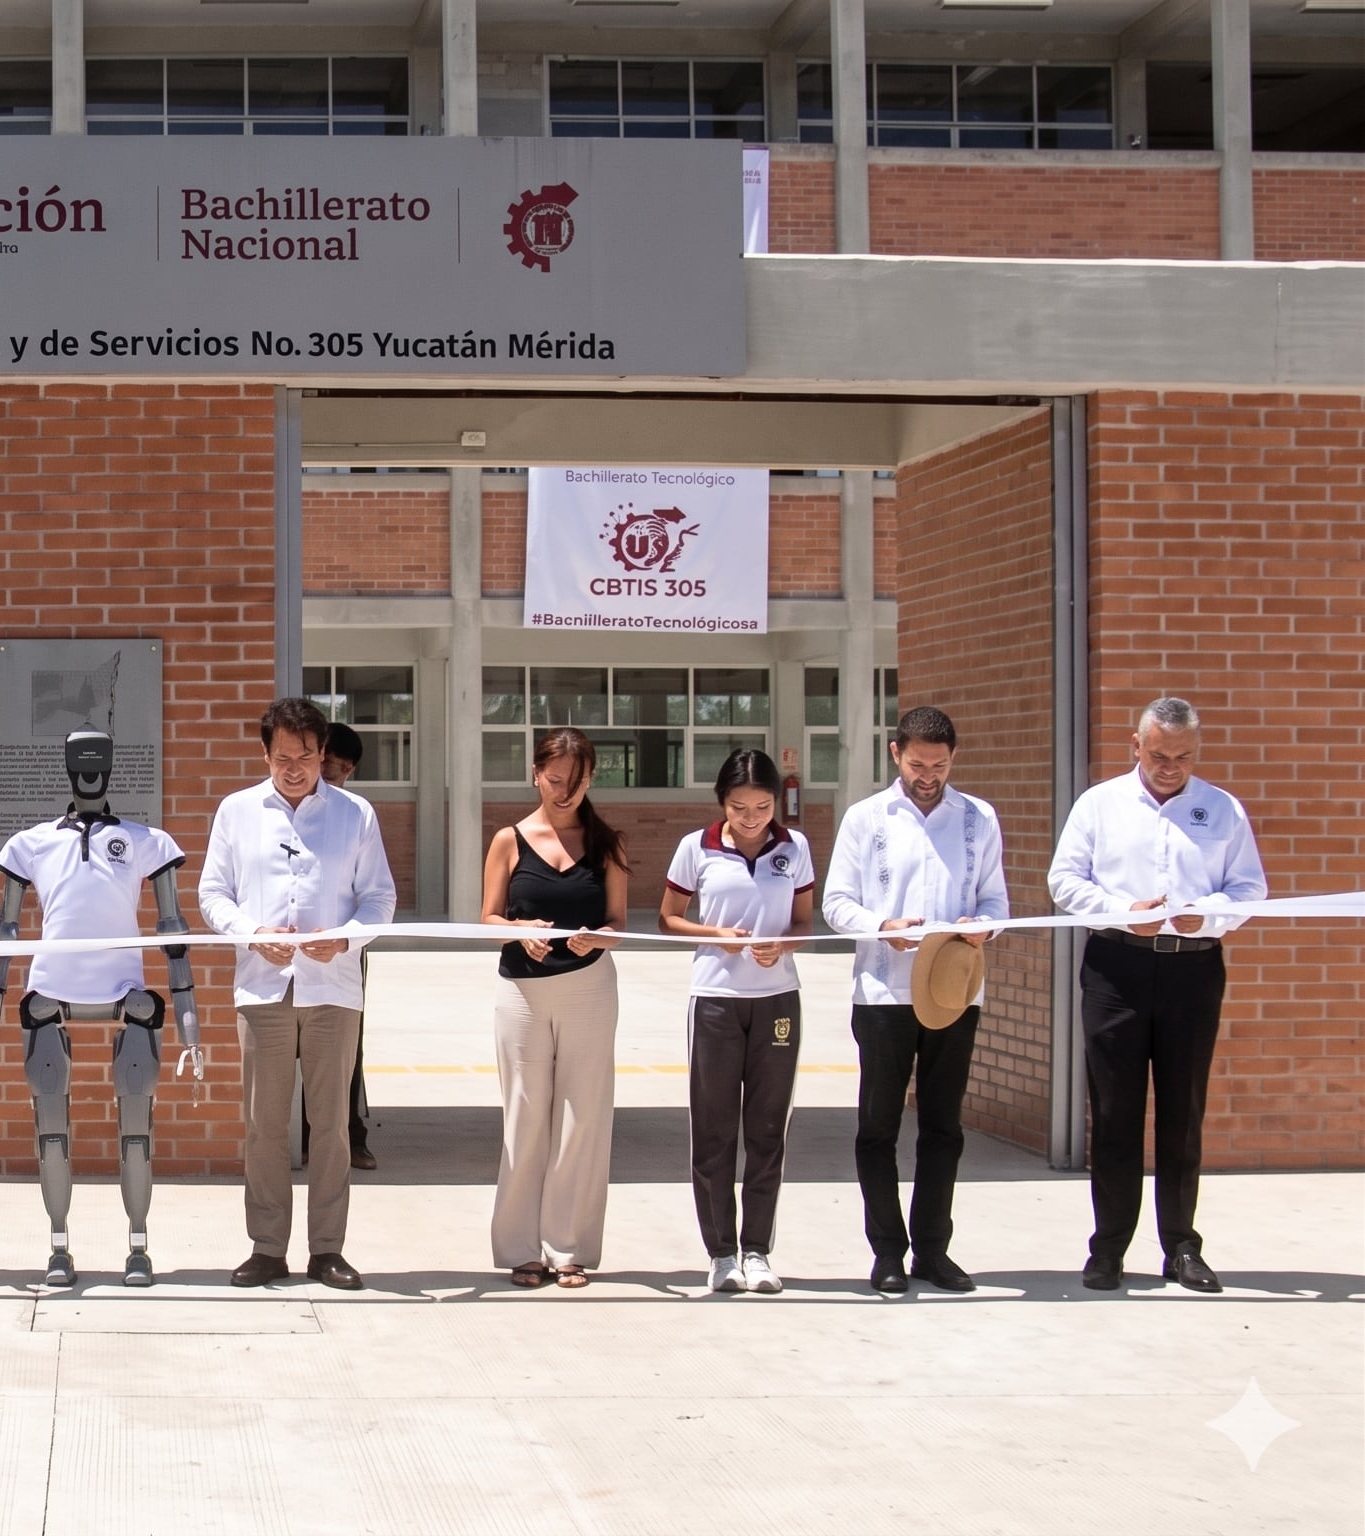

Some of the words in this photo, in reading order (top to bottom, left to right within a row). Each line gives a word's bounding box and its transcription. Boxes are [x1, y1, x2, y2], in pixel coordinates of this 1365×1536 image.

[181, 187, 431, 222] Bachillerato
[181, 228, 360, 260] Nacional
[10, 336, 29, 364] y
[40, 328, 79, 357] de
[90, 328, 240, 357] Servicios
[252, 330, 302, 357] No.
[308, 332, 364, 358] 305
[373, 329, 497, 359] Yucatán
[509, 330, 616, 360] Mérida
[565, 470, 648, 484] Bachillerato
[651, 471, 736, 488] Tecnológico
[589, 577, 658, 597] CBTIS
[664, 579, 707, 598] 305
